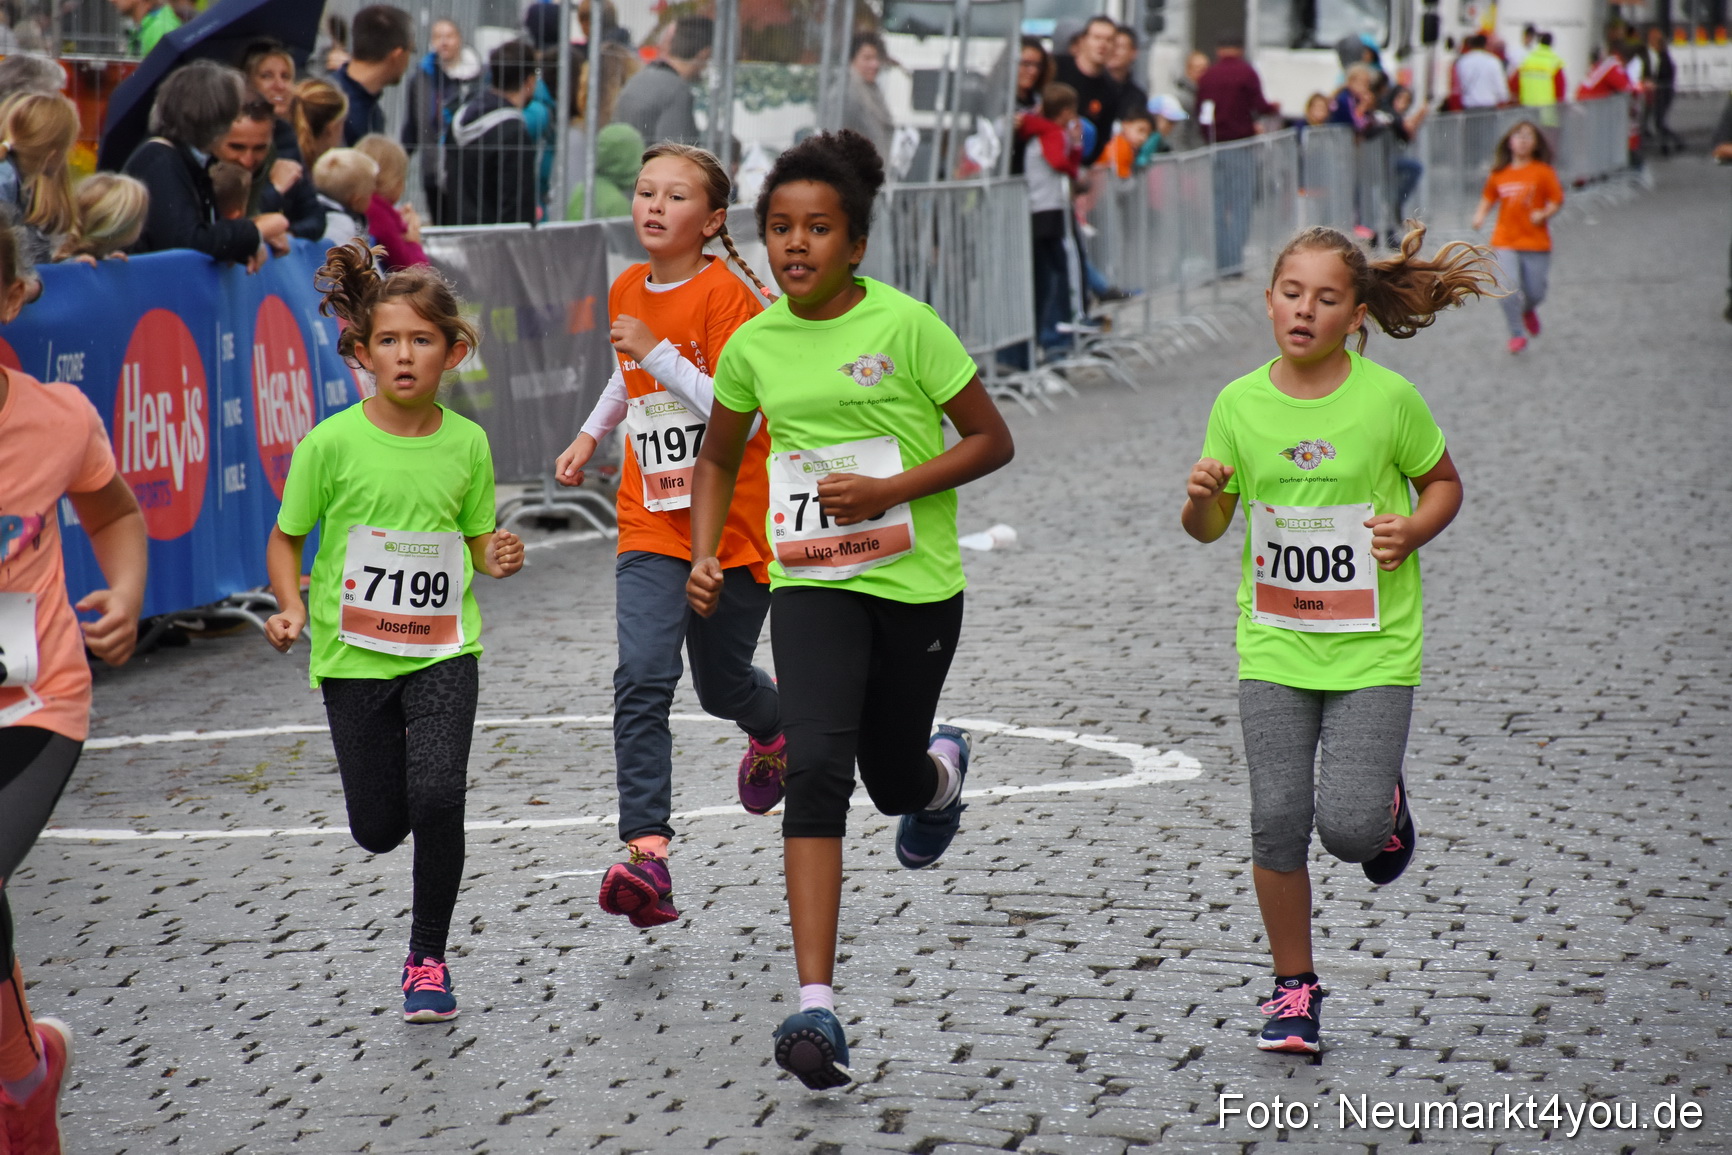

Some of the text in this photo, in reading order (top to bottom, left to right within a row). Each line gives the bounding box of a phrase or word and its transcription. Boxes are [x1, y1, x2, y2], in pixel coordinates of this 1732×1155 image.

[839, 396, 899, 406] Dorfner-Apotheken
[121, 361, 205, 492] Hervis
[637, 423, 706, 467] 7197
[813, 456, 857, 472] BOCK
[660, 477, 684, 491] Mira
[1279, 476, 1338, 484] Dorfner-Apotheken
[1288, 518, 1335, 530] BOCK
[398, 543, 439, 555] BOCK
[805, 538, 880, 561] Liya-Marie
[1268, 541, 1356, 584] 7008
[363, 565, 450, 609] 7199
[345, 592, 354, 601] B5
[1293, 596, 1324, 611] Jana
[376, 618, 431, 636] Josefine
